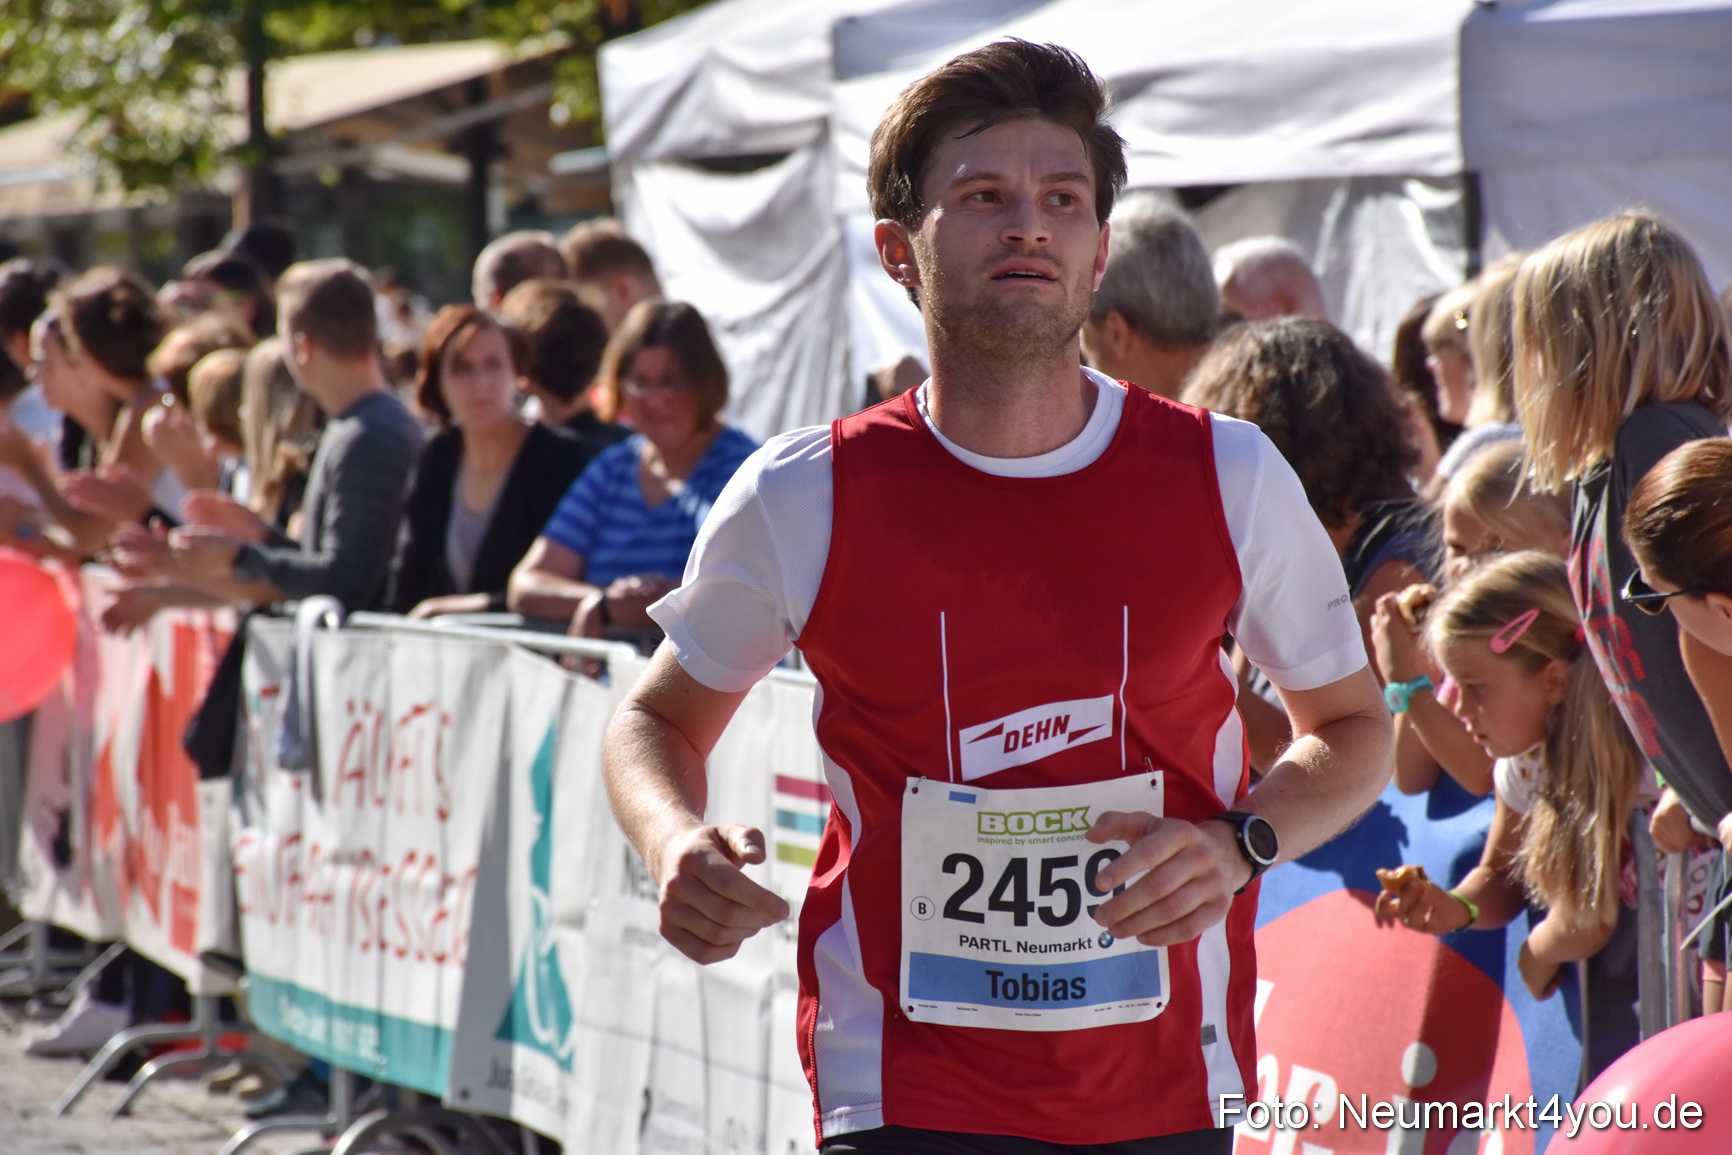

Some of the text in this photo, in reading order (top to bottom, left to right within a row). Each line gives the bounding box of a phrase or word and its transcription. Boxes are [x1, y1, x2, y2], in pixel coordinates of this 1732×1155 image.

[1003, 714, 1071, 754] DEHN
[977, 805, 1092, 836] BOCK
[977, 834, 1086, 846] inspired by smart concep
[942, 848, 1126, 928] 2459
[918, 902, 927, 915] B
[959, 934, 1093, 954] PARTL Neumarkt
[985, 970, 1087, 1001] Tobias
